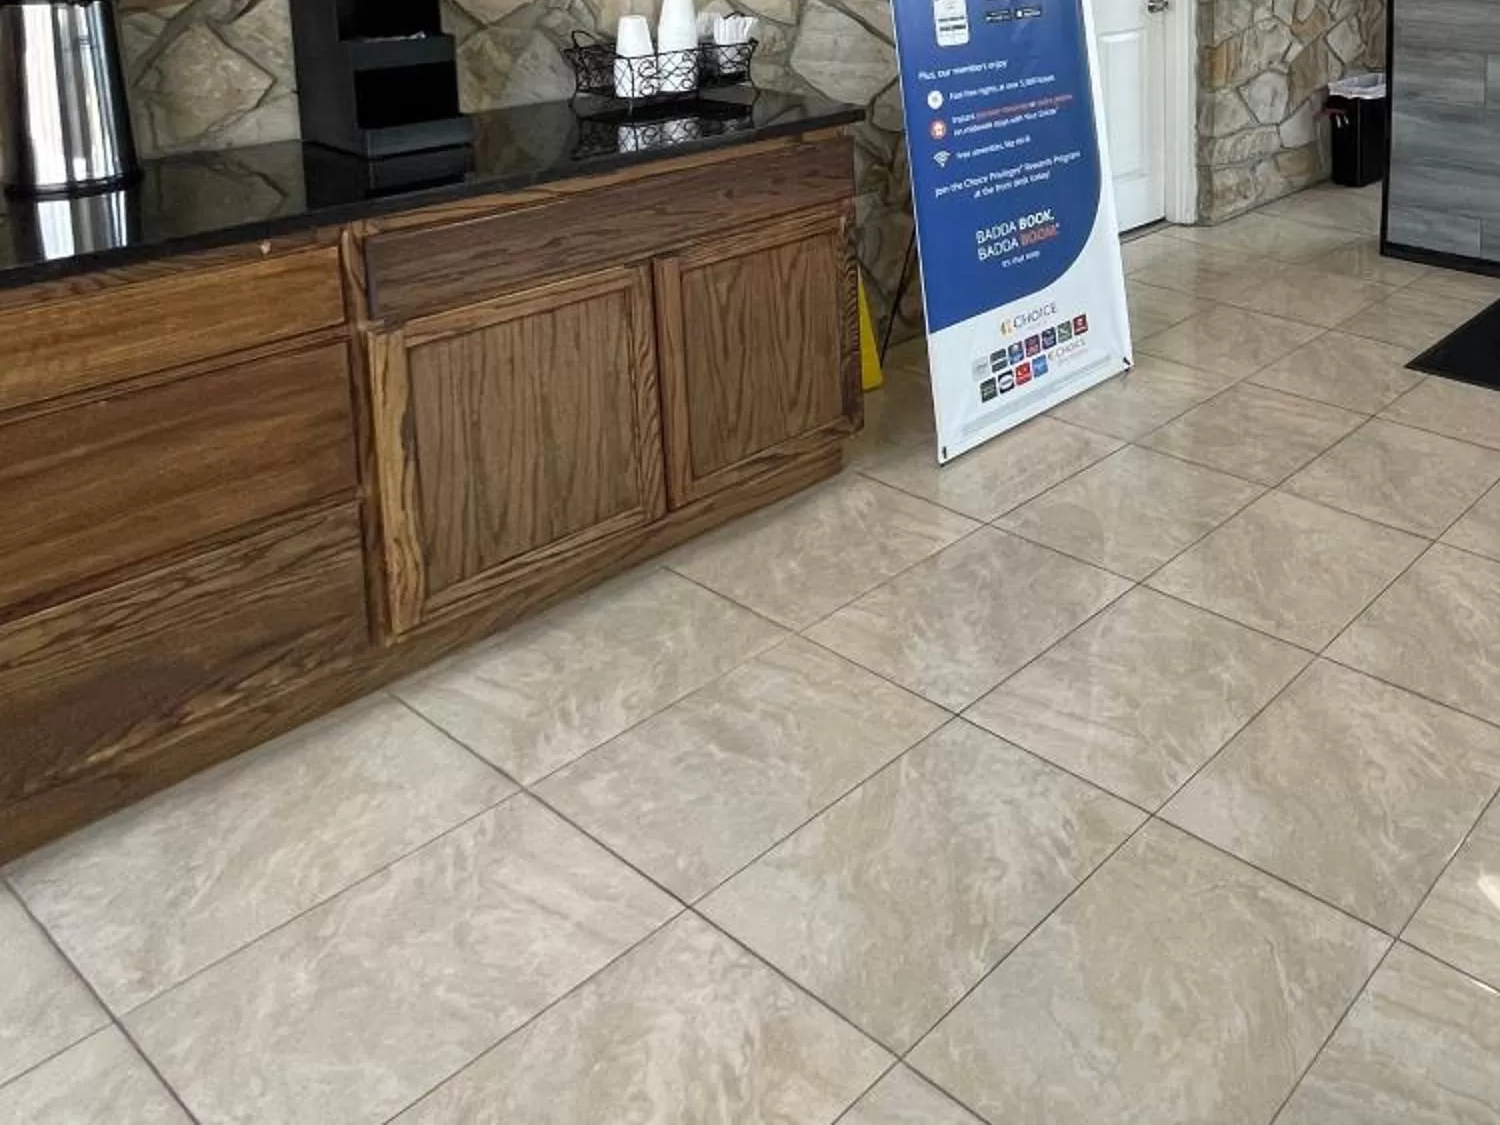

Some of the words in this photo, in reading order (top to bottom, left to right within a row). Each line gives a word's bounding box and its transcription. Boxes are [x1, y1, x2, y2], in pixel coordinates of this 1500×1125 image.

[976, 221, 1016, 244] BADDA
[1019, 209, 1054, 230] BOOK.
[978, 238, 1018, 261] BADDA
[1013, 303, 1057, 328] CHOICE
